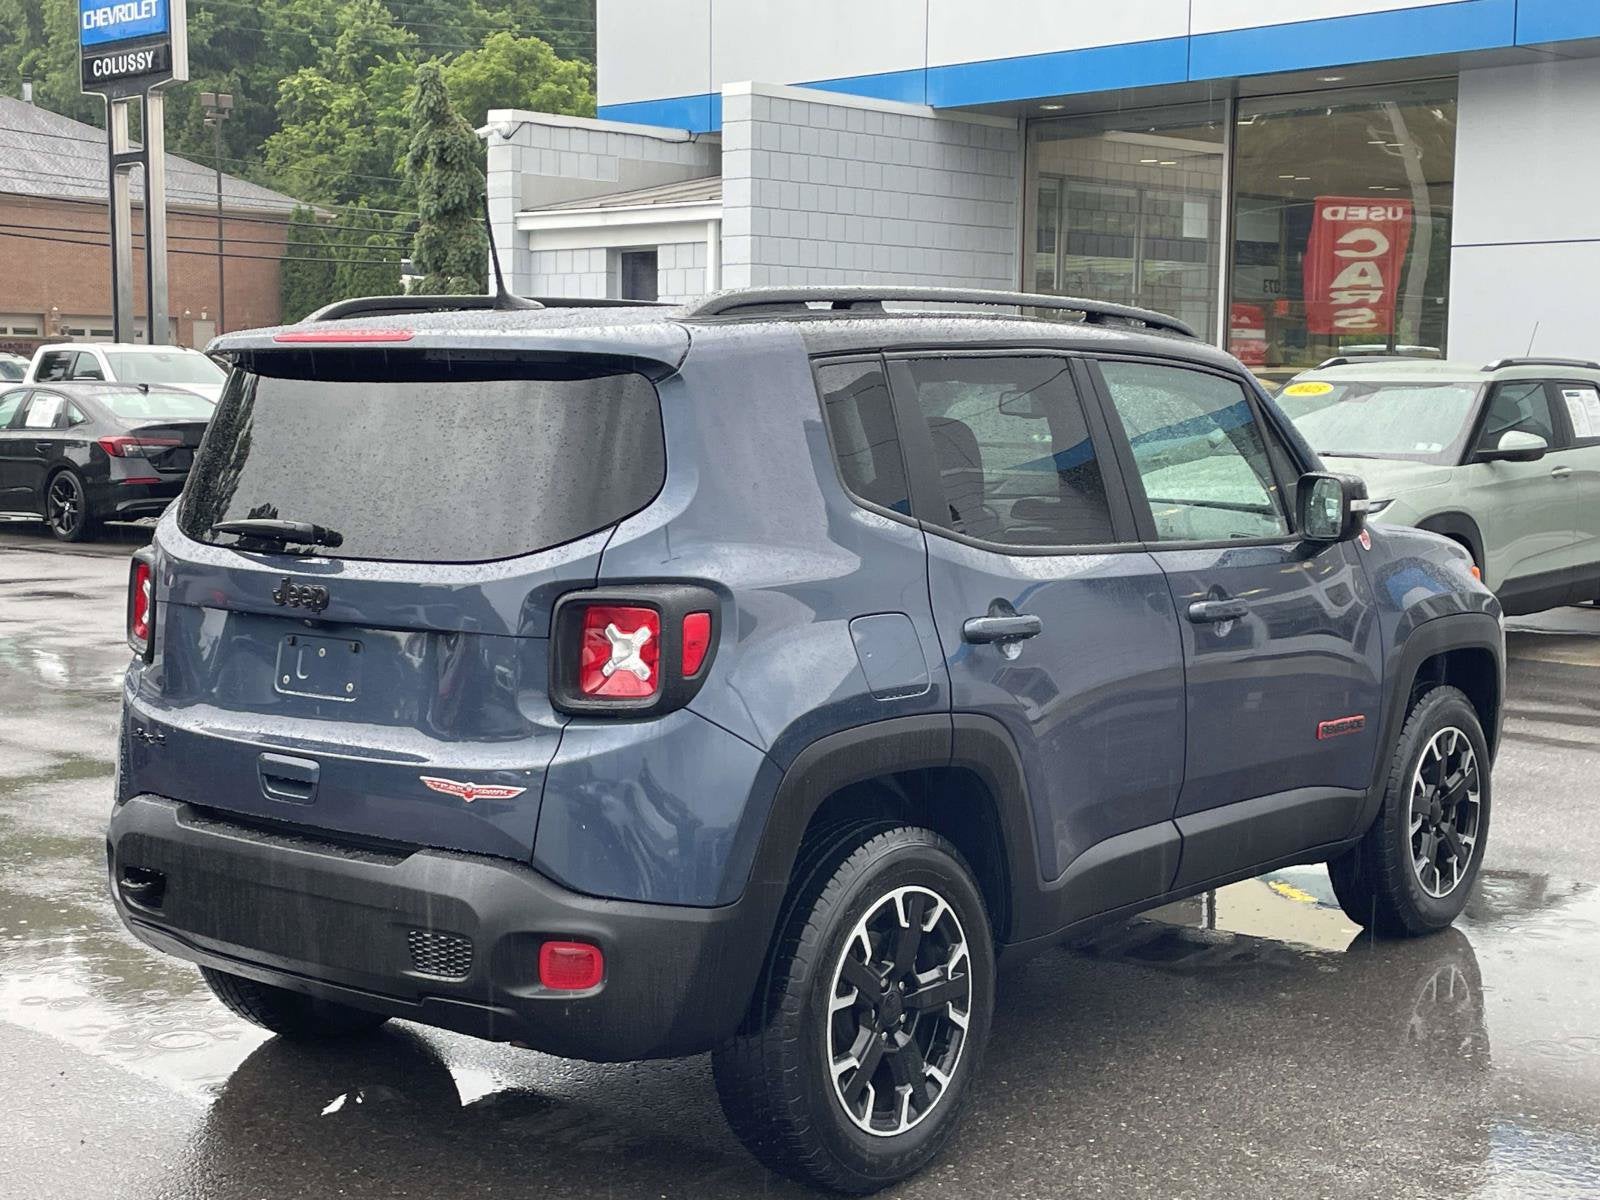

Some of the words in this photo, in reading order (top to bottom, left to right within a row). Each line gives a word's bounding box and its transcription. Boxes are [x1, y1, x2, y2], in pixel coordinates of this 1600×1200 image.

[83, 0, 158, 29] CHEVROLET
[93, 50, 154, 77] COLUSSY
[272, 577, 330, 613] Jeep
